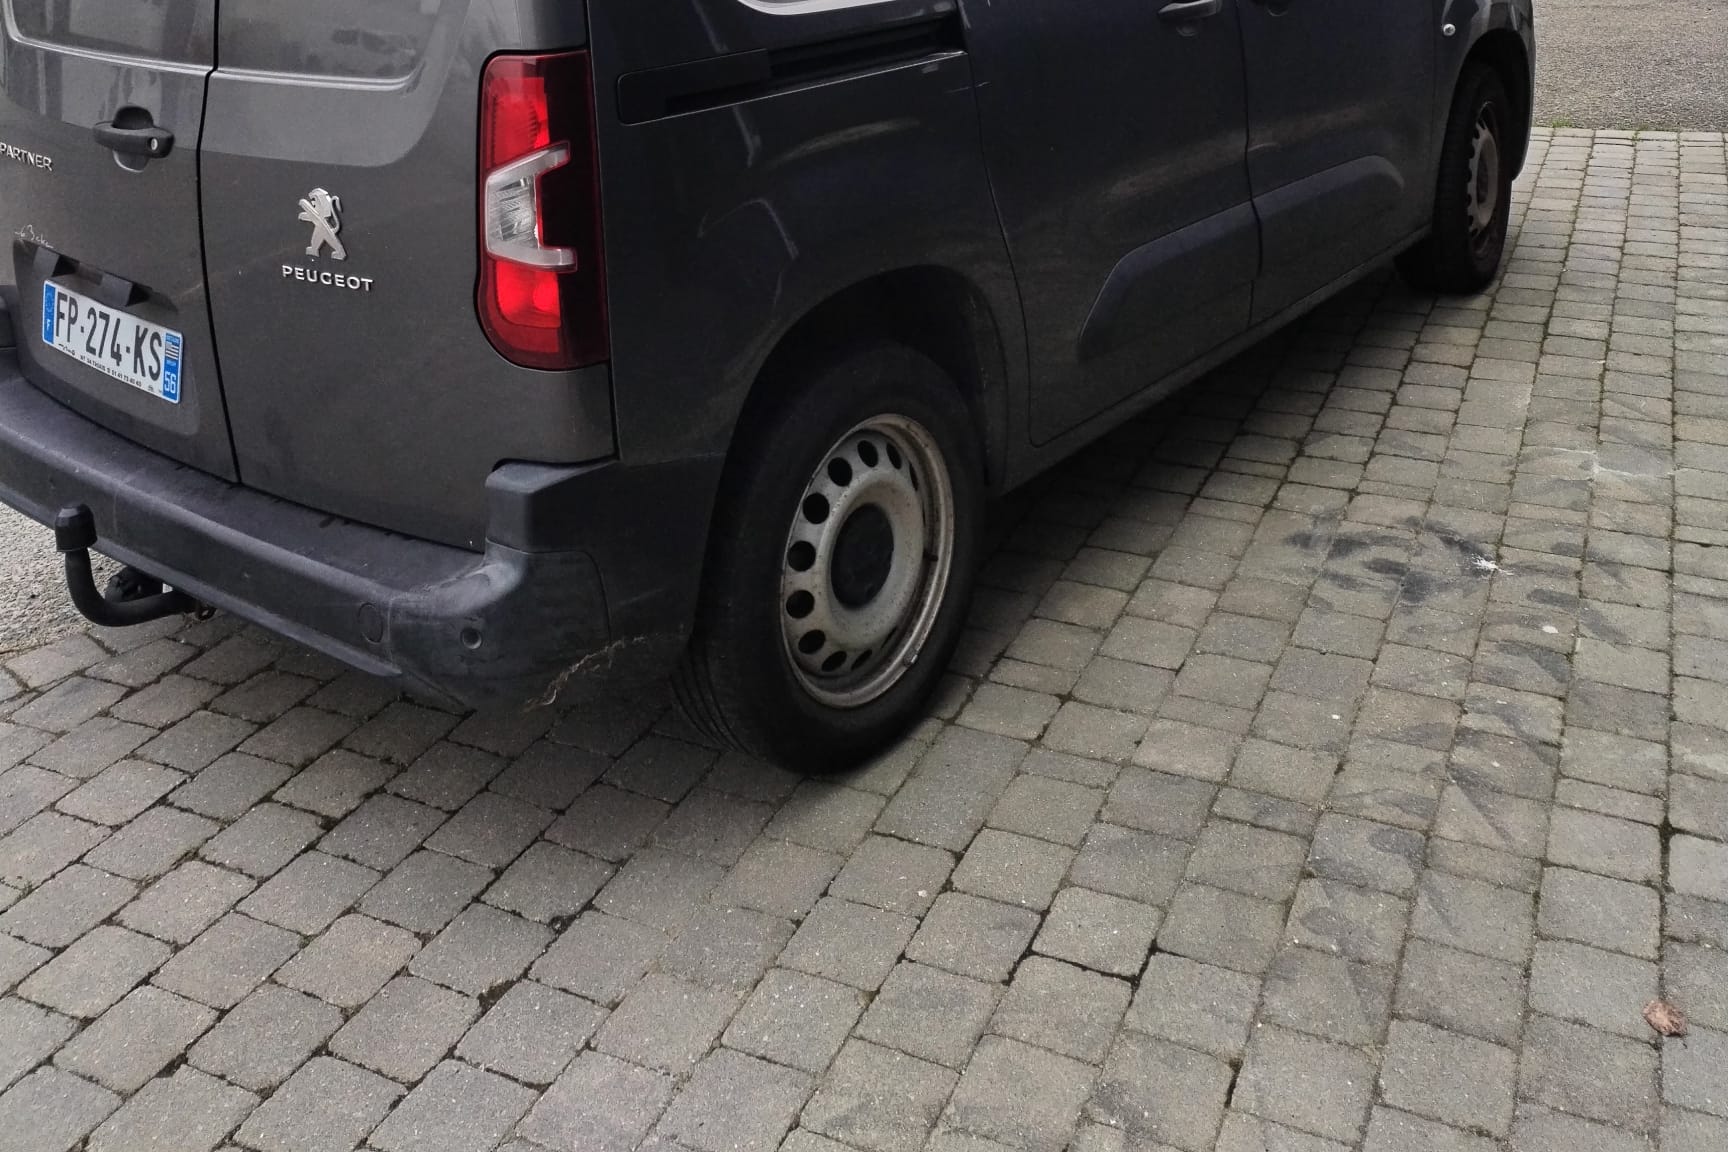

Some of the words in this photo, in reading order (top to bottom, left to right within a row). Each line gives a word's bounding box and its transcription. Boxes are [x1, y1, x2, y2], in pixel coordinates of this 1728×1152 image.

[0, 141, 53, 172] PARTNER
[281, 264, 374, 292] PEUGEOT
[164, 371, 177, 394] 56
